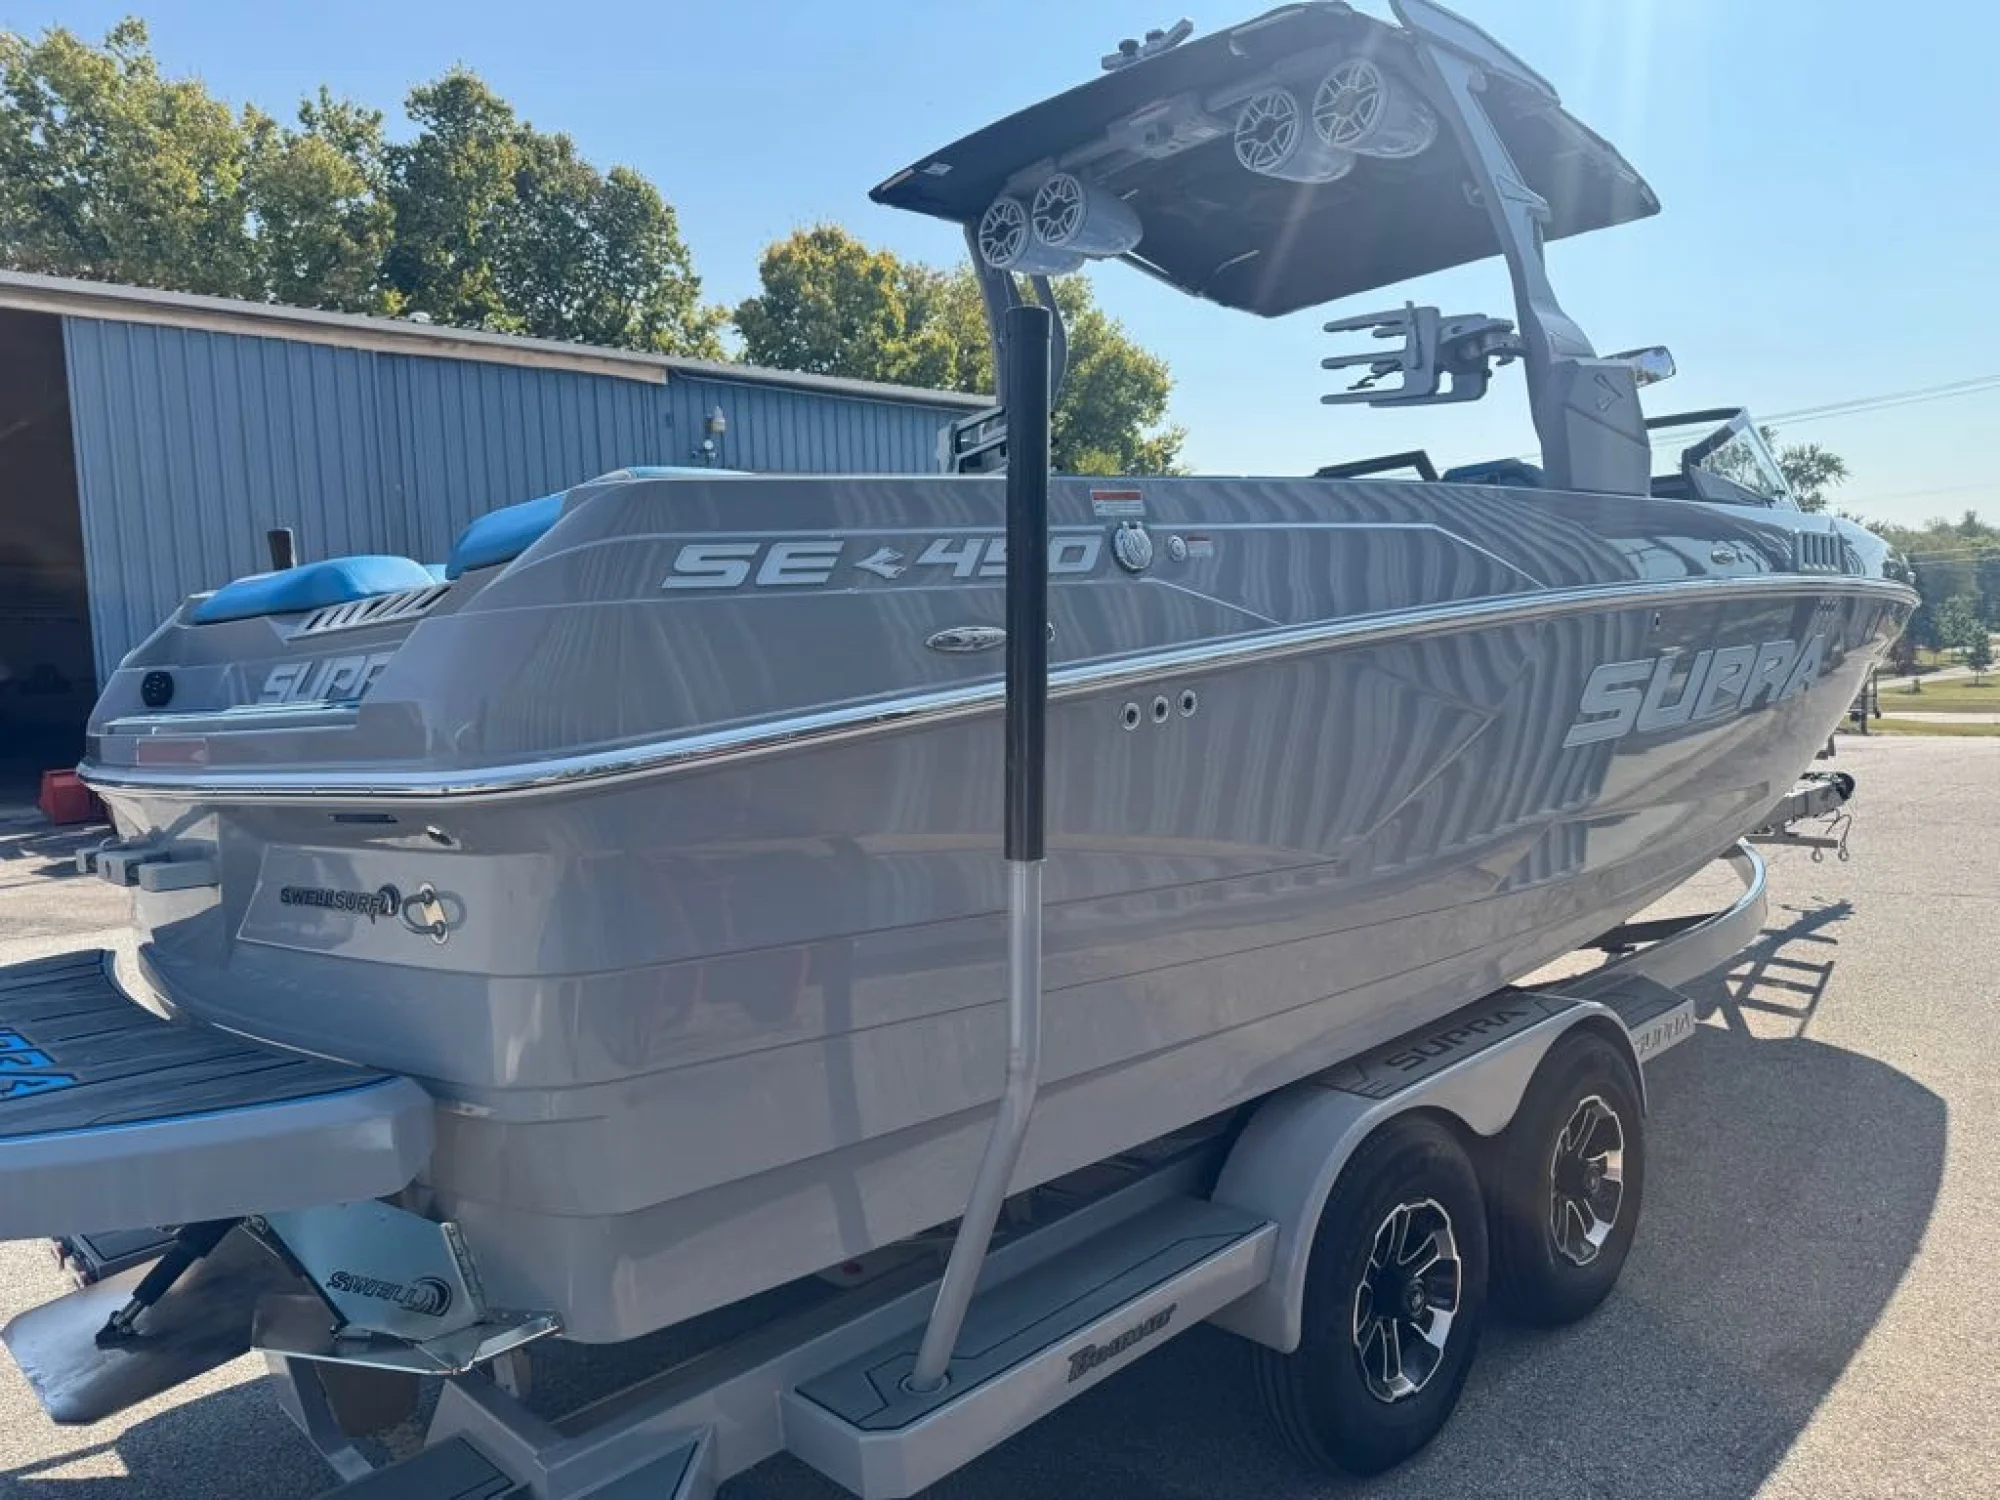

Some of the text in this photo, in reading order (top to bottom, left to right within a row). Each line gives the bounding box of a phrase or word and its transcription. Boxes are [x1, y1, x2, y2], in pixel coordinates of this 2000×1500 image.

[661, 541, 845, 589] SE
[1562, 634, 1825, 749] SUPRA
[1385, 1010, 1528, 1072] SUPRA
